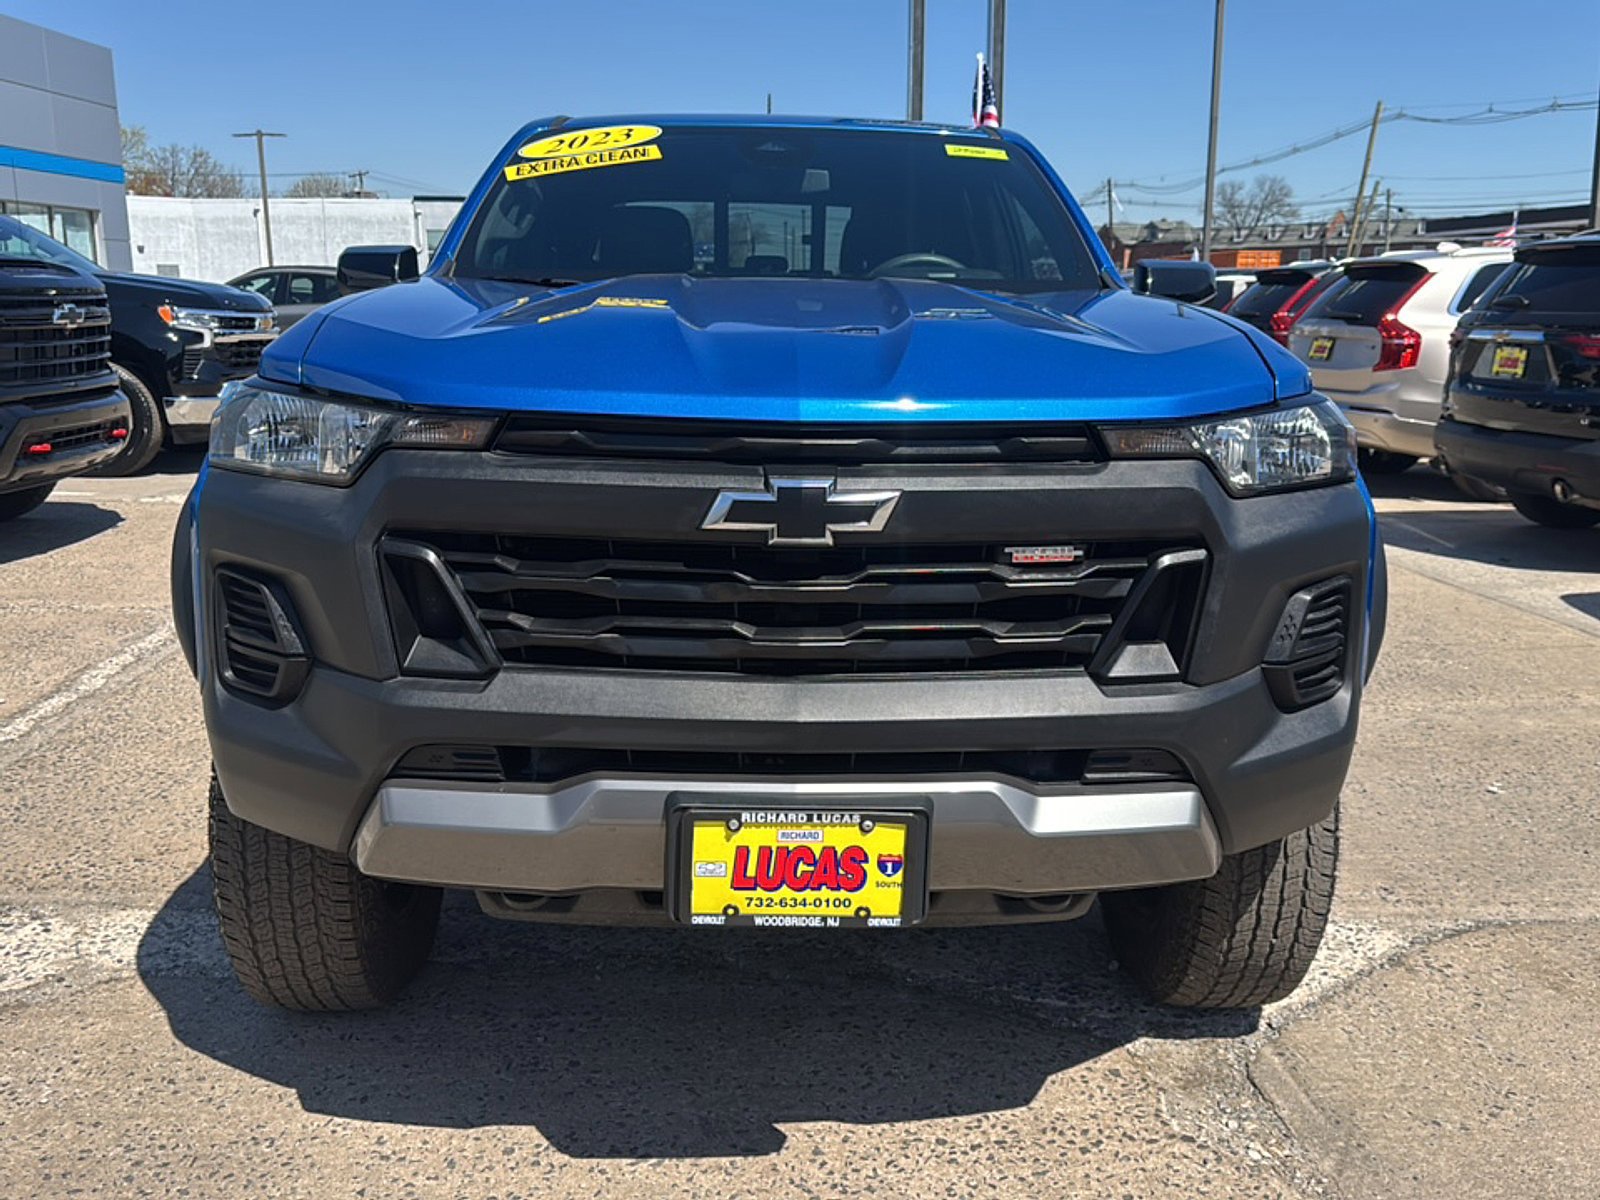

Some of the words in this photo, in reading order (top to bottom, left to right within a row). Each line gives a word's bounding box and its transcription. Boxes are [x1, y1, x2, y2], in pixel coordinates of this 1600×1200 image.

[545, 128, 634, 154] 2023
[516, 157, 580, 176] EXTRA
[741, 812, 807, 823] RICHARD
[813, 814, 861, 824] LUCAS
[780, 831, 819, 840] RICHARD
[731, 846, 869, 892] LUCAS
[885, 862, 893, 875] 1
[745, 897, 852, 908] 732-634-0100
[827, 917, 840, 927] NJ
